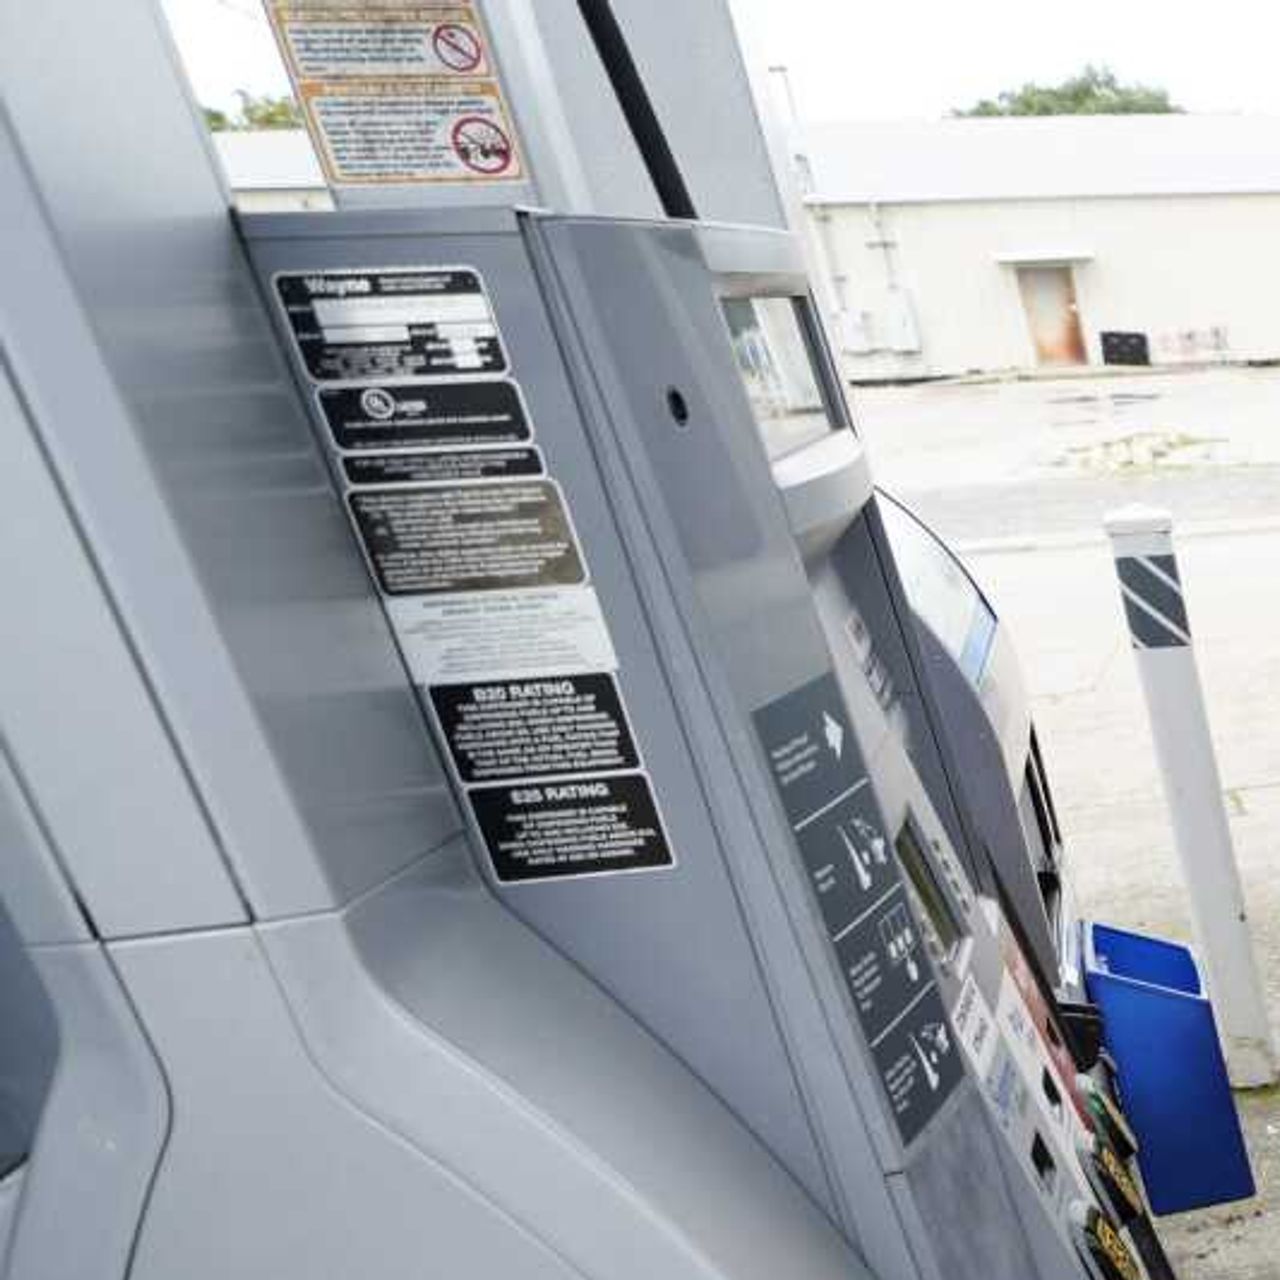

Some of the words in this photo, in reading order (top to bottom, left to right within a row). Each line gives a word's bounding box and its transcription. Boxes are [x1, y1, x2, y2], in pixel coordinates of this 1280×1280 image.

[304, 278, 371, 296] Wayne
[509, 681, 575, 699] RATING
[545, 783, 609, 801] RATING
